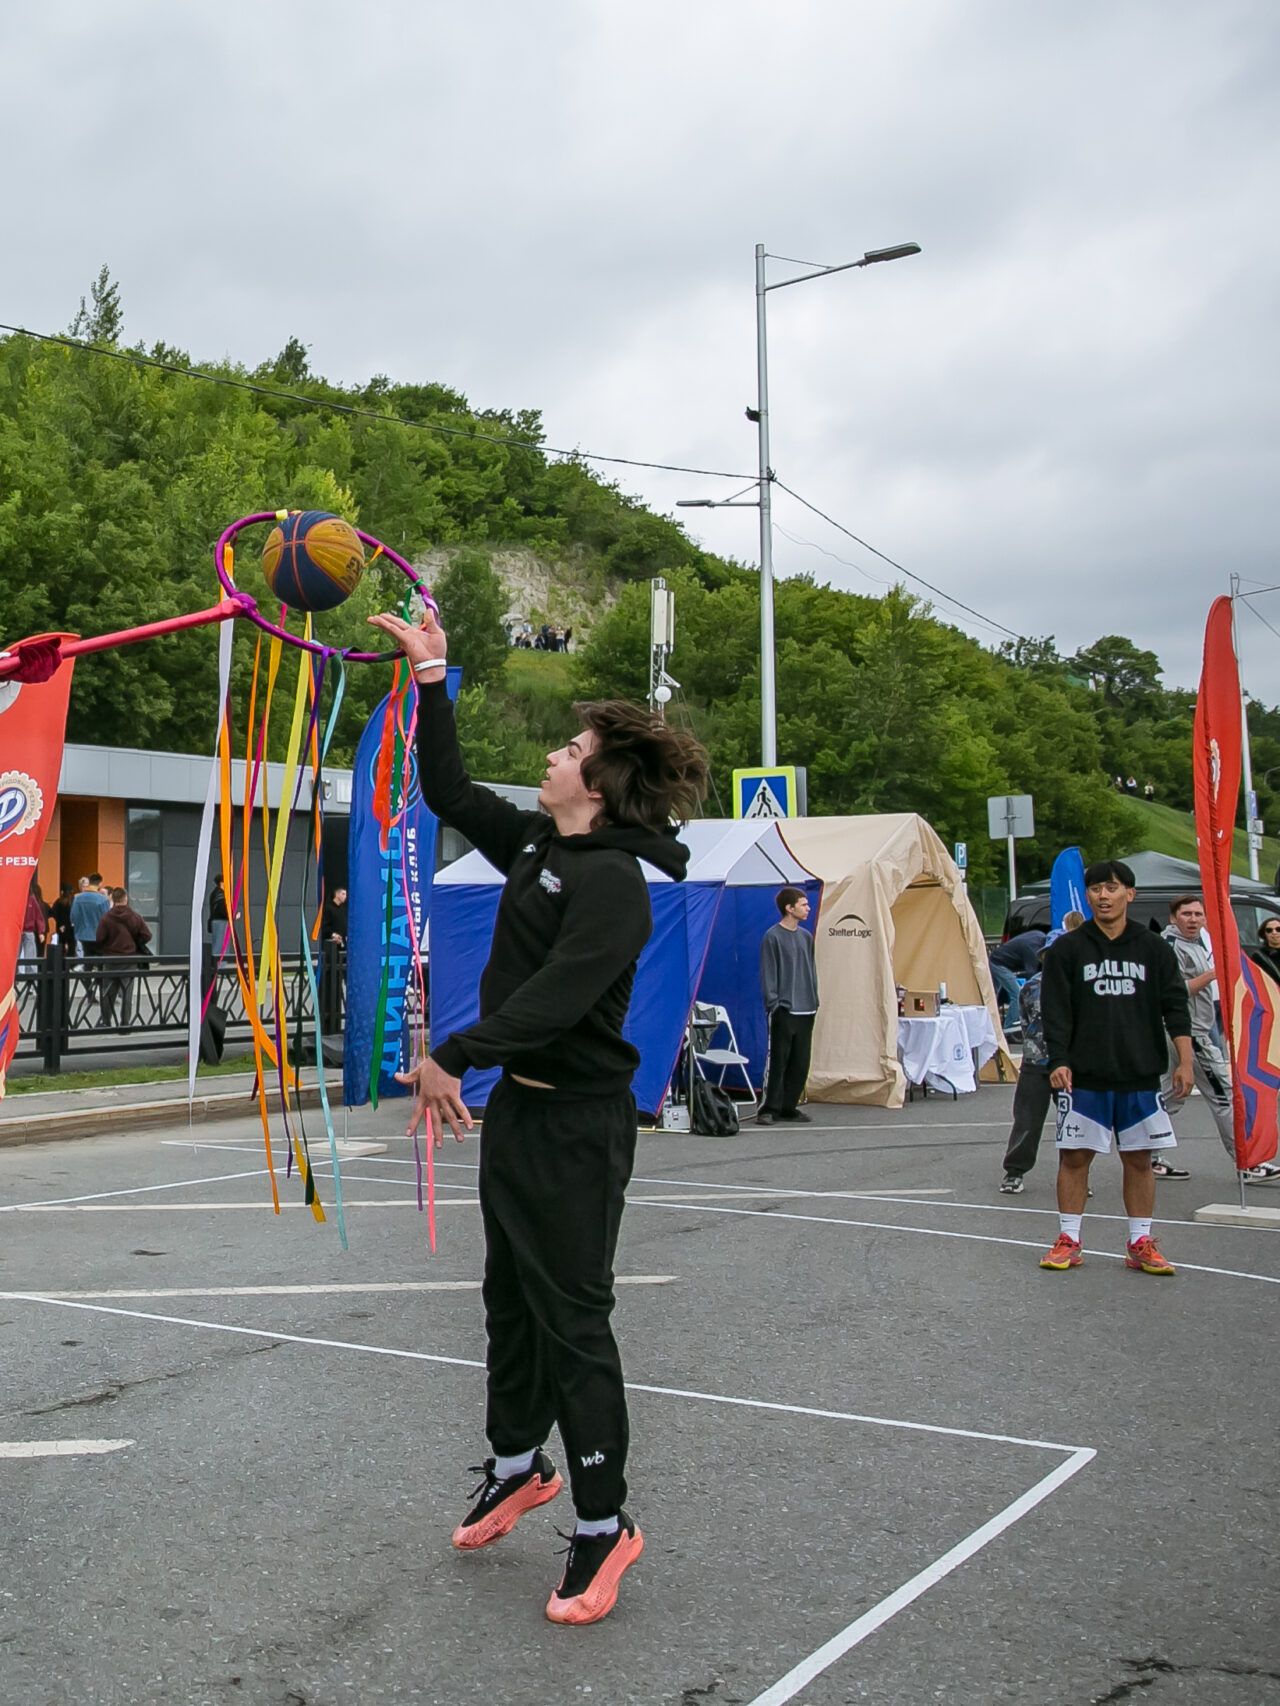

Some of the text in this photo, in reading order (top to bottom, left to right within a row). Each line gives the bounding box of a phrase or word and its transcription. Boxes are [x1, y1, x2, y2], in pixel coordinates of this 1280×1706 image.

[407, 827, 419, 883] КЛУБ
[379, 827, 410, 1079] ДИНАМО
[1093, 978, 1136, 996] CLUB
[580, 1451, 604, 1467] wb
